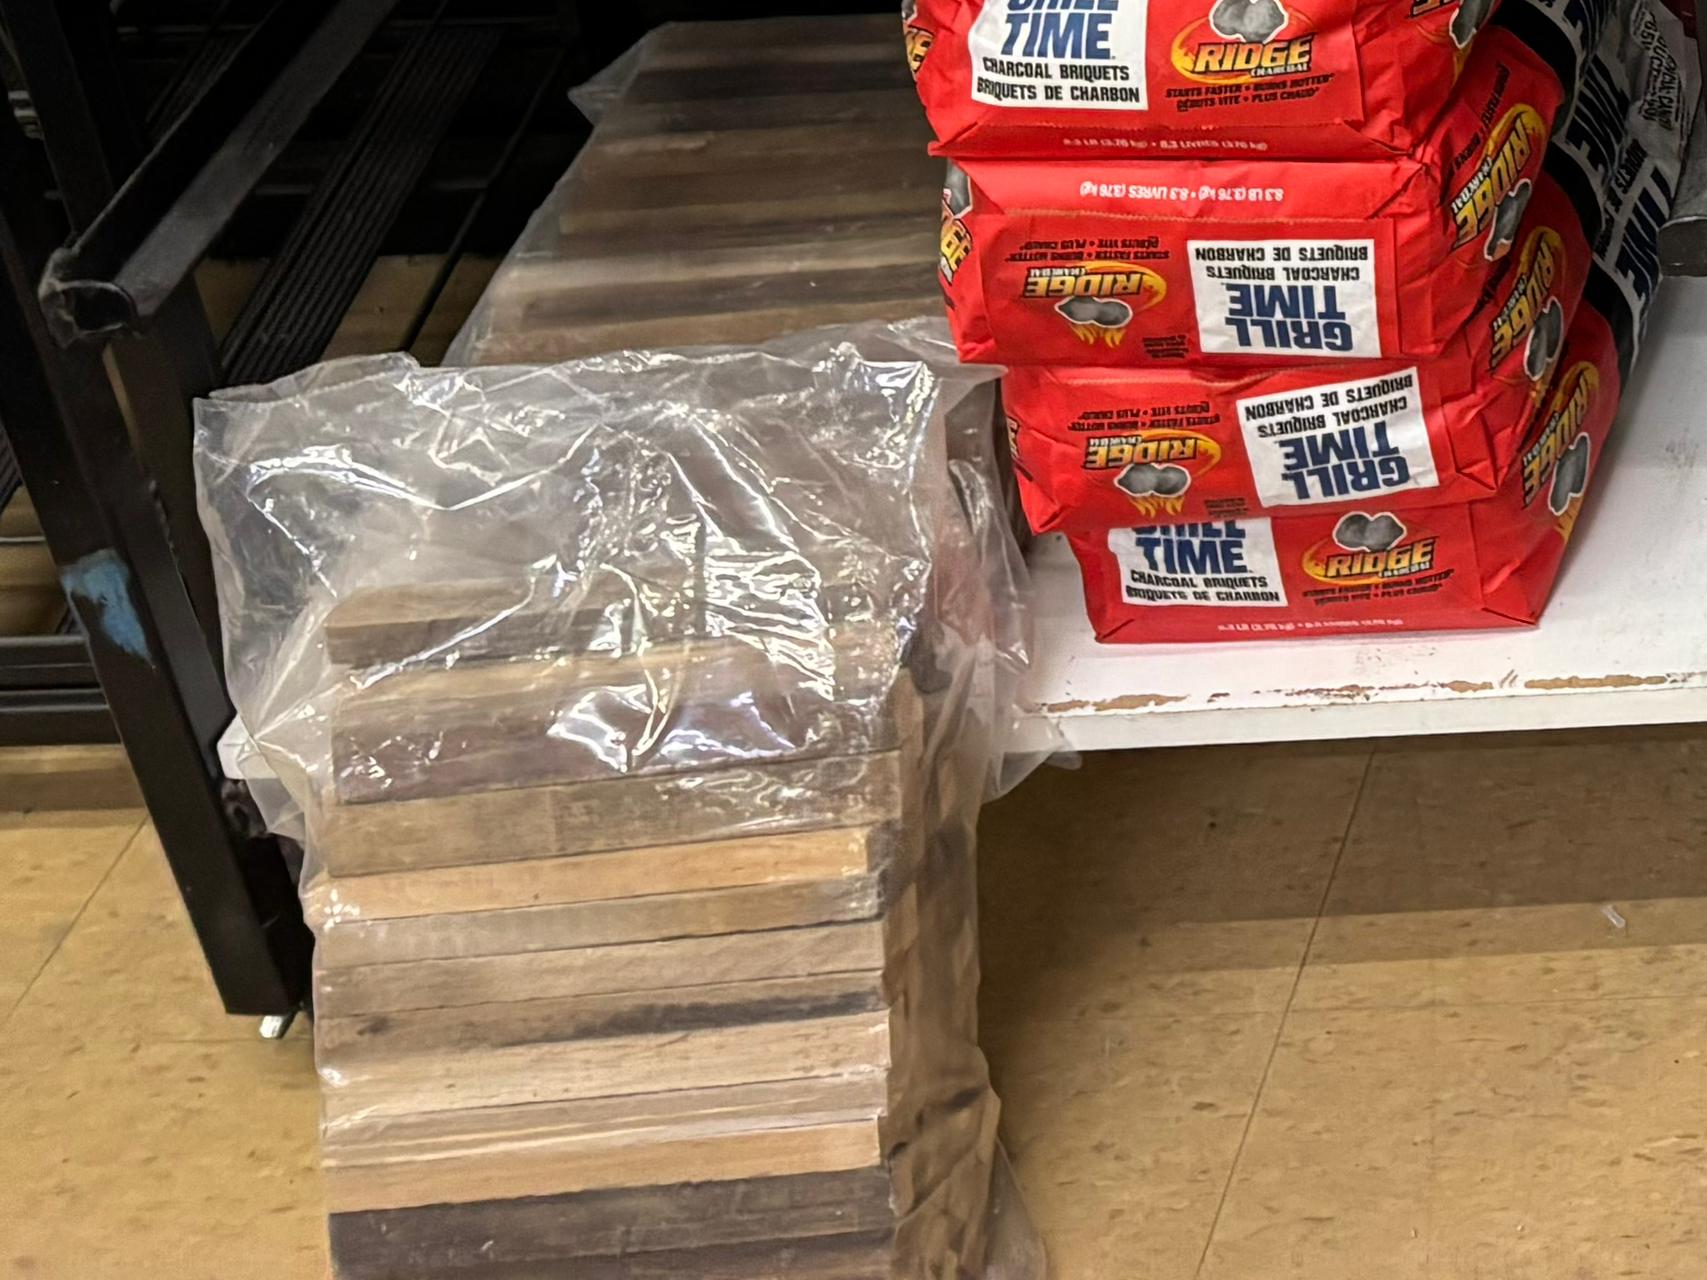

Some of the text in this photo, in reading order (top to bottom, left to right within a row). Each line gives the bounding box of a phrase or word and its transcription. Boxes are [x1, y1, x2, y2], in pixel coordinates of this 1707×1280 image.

[1000, 13, 1112, 60] TIME
[983, 58, 1130, 80] CHARCOAL BRIQUETS
[1194, 35, 1313, 74] RIDGE
[977, 77, 1139, 103] BRIQUETS DE CHARBON
[1225, 283, 1346, 319] TIME
[1225, 317, 1353, 352] GRILL
